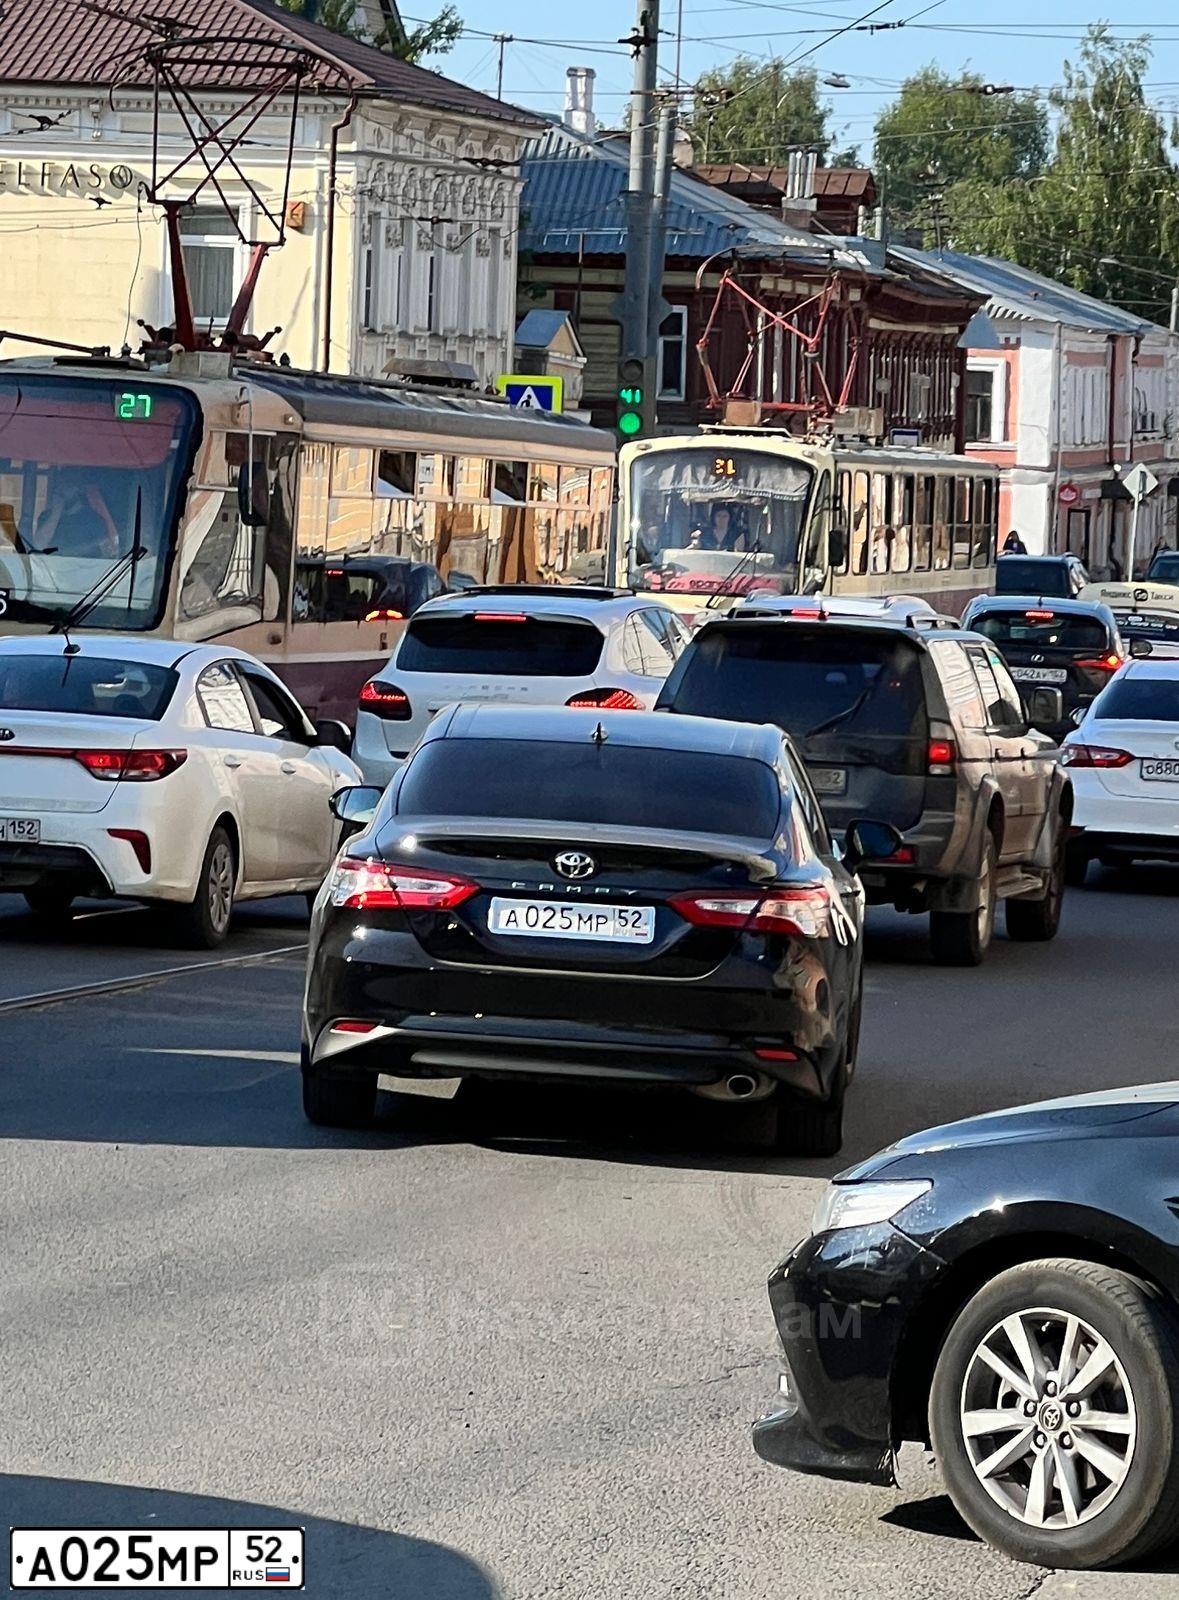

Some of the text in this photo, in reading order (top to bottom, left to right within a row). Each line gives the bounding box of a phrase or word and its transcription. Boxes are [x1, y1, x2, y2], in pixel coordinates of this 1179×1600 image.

[121, 393, 151, 418] 27
[620, 389, 641, 404] 41
[9, 820, 35, 836] 152
[505, 905, 643, 933] А025МР 52
